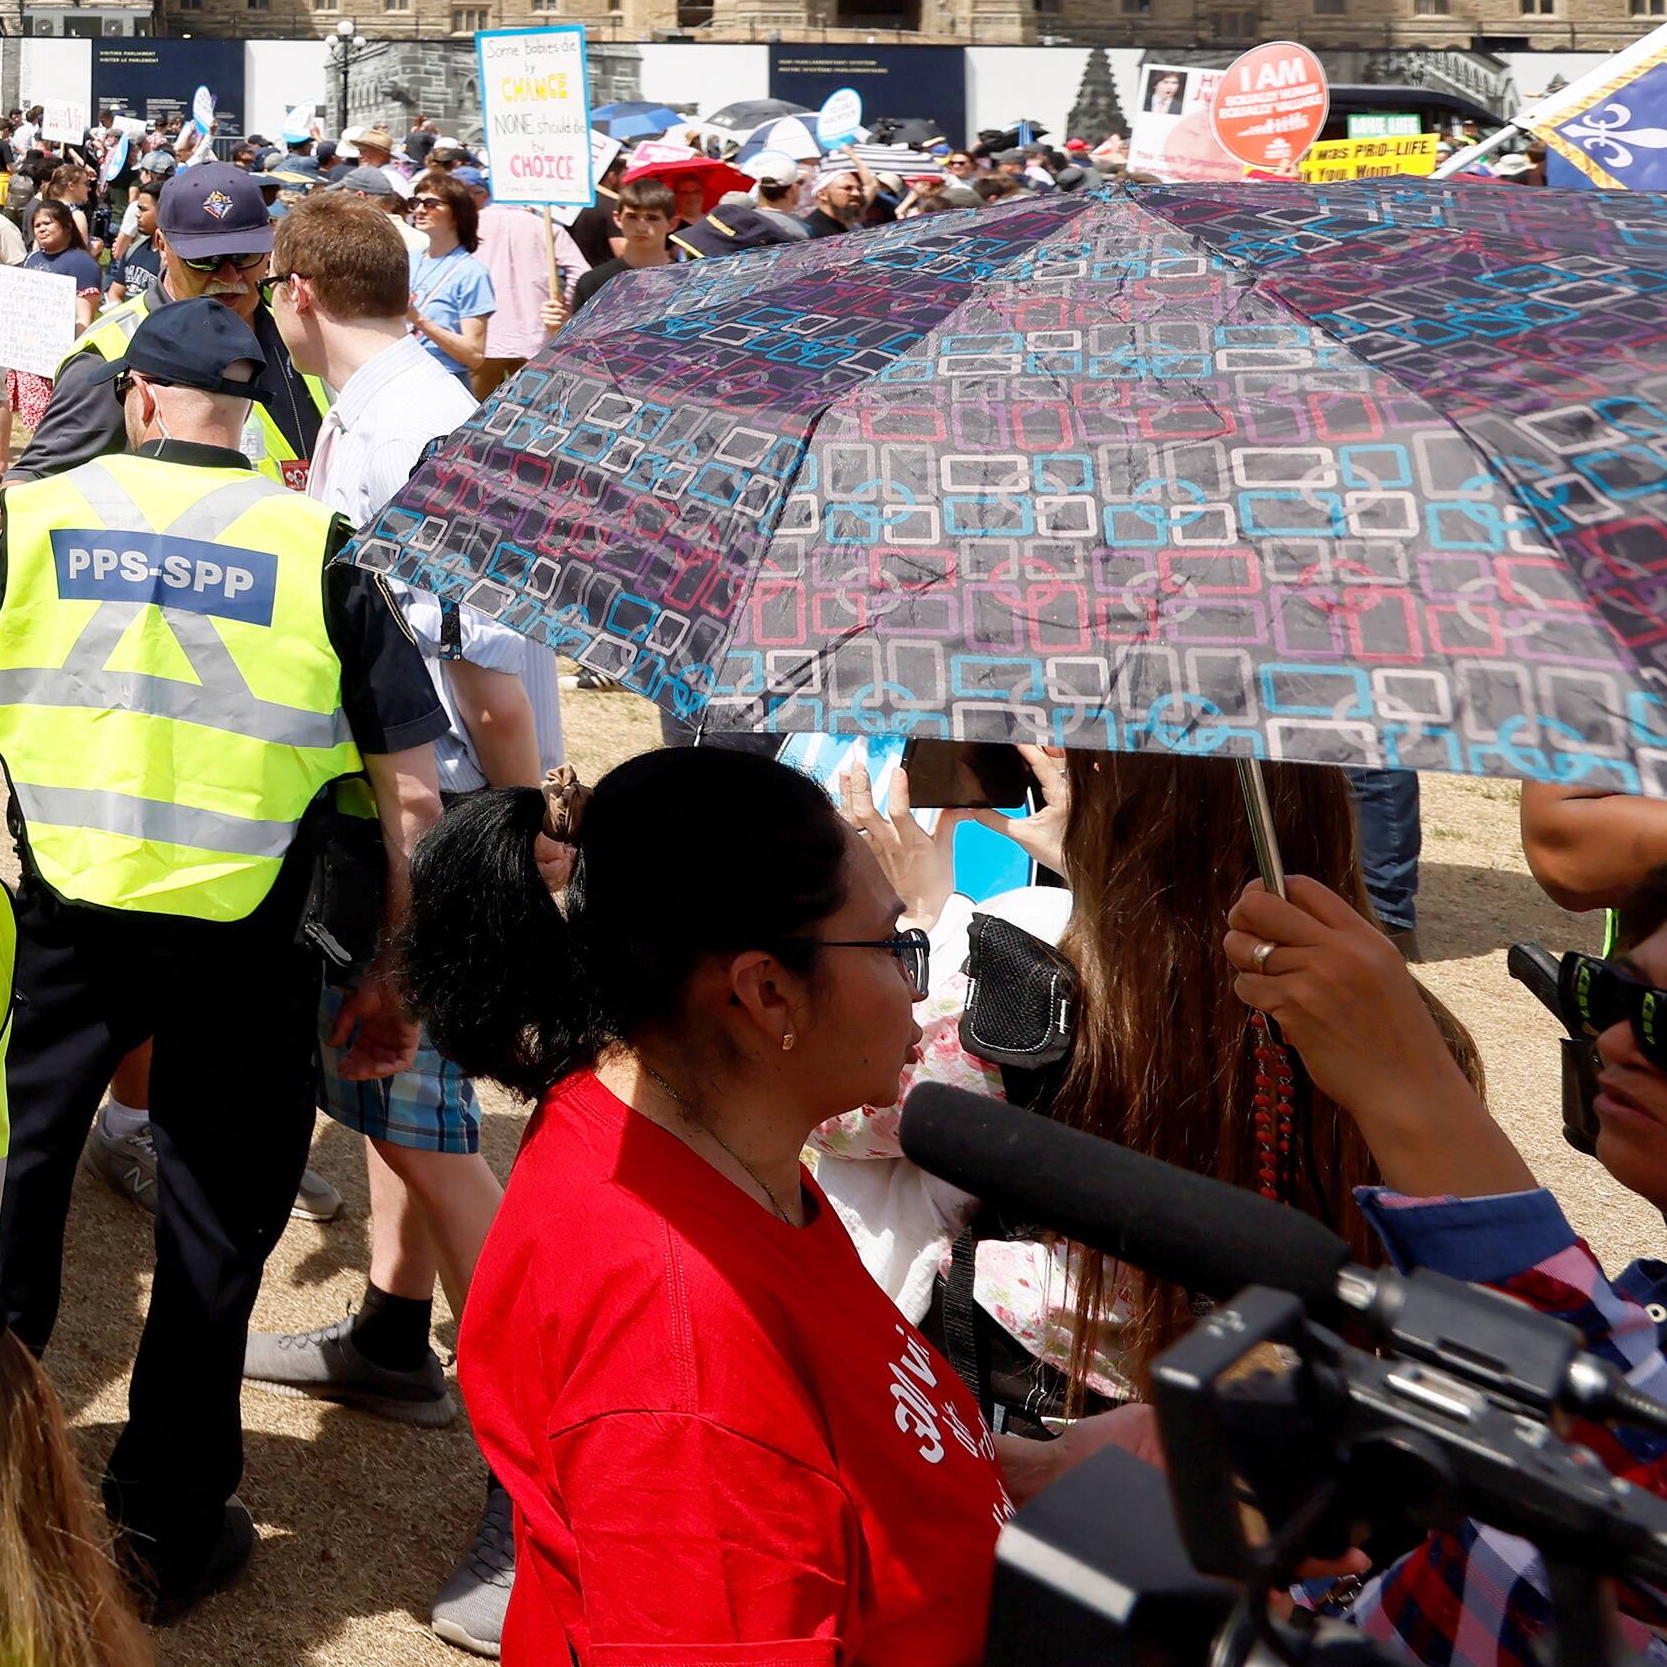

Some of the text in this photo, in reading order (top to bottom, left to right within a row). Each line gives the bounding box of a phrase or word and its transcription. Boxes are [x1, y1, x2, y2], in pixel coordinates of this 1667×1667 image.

[486, 36, 577, 59] Some babies die
[524, 60, 535, 75] by
[1239, 65, 1251, 92] I
[1255, 56, 1308, 91] AM
[501, 72, 568, 103] CHANCE
[1279, 82, 1320, 99] HUMAN
[494, 113, 534, 136] NONE
[532, 141, 545, 154] by
[509, 155, 574, 180] CHOICE
[69, 547, 254, 599] PPS-SPP
